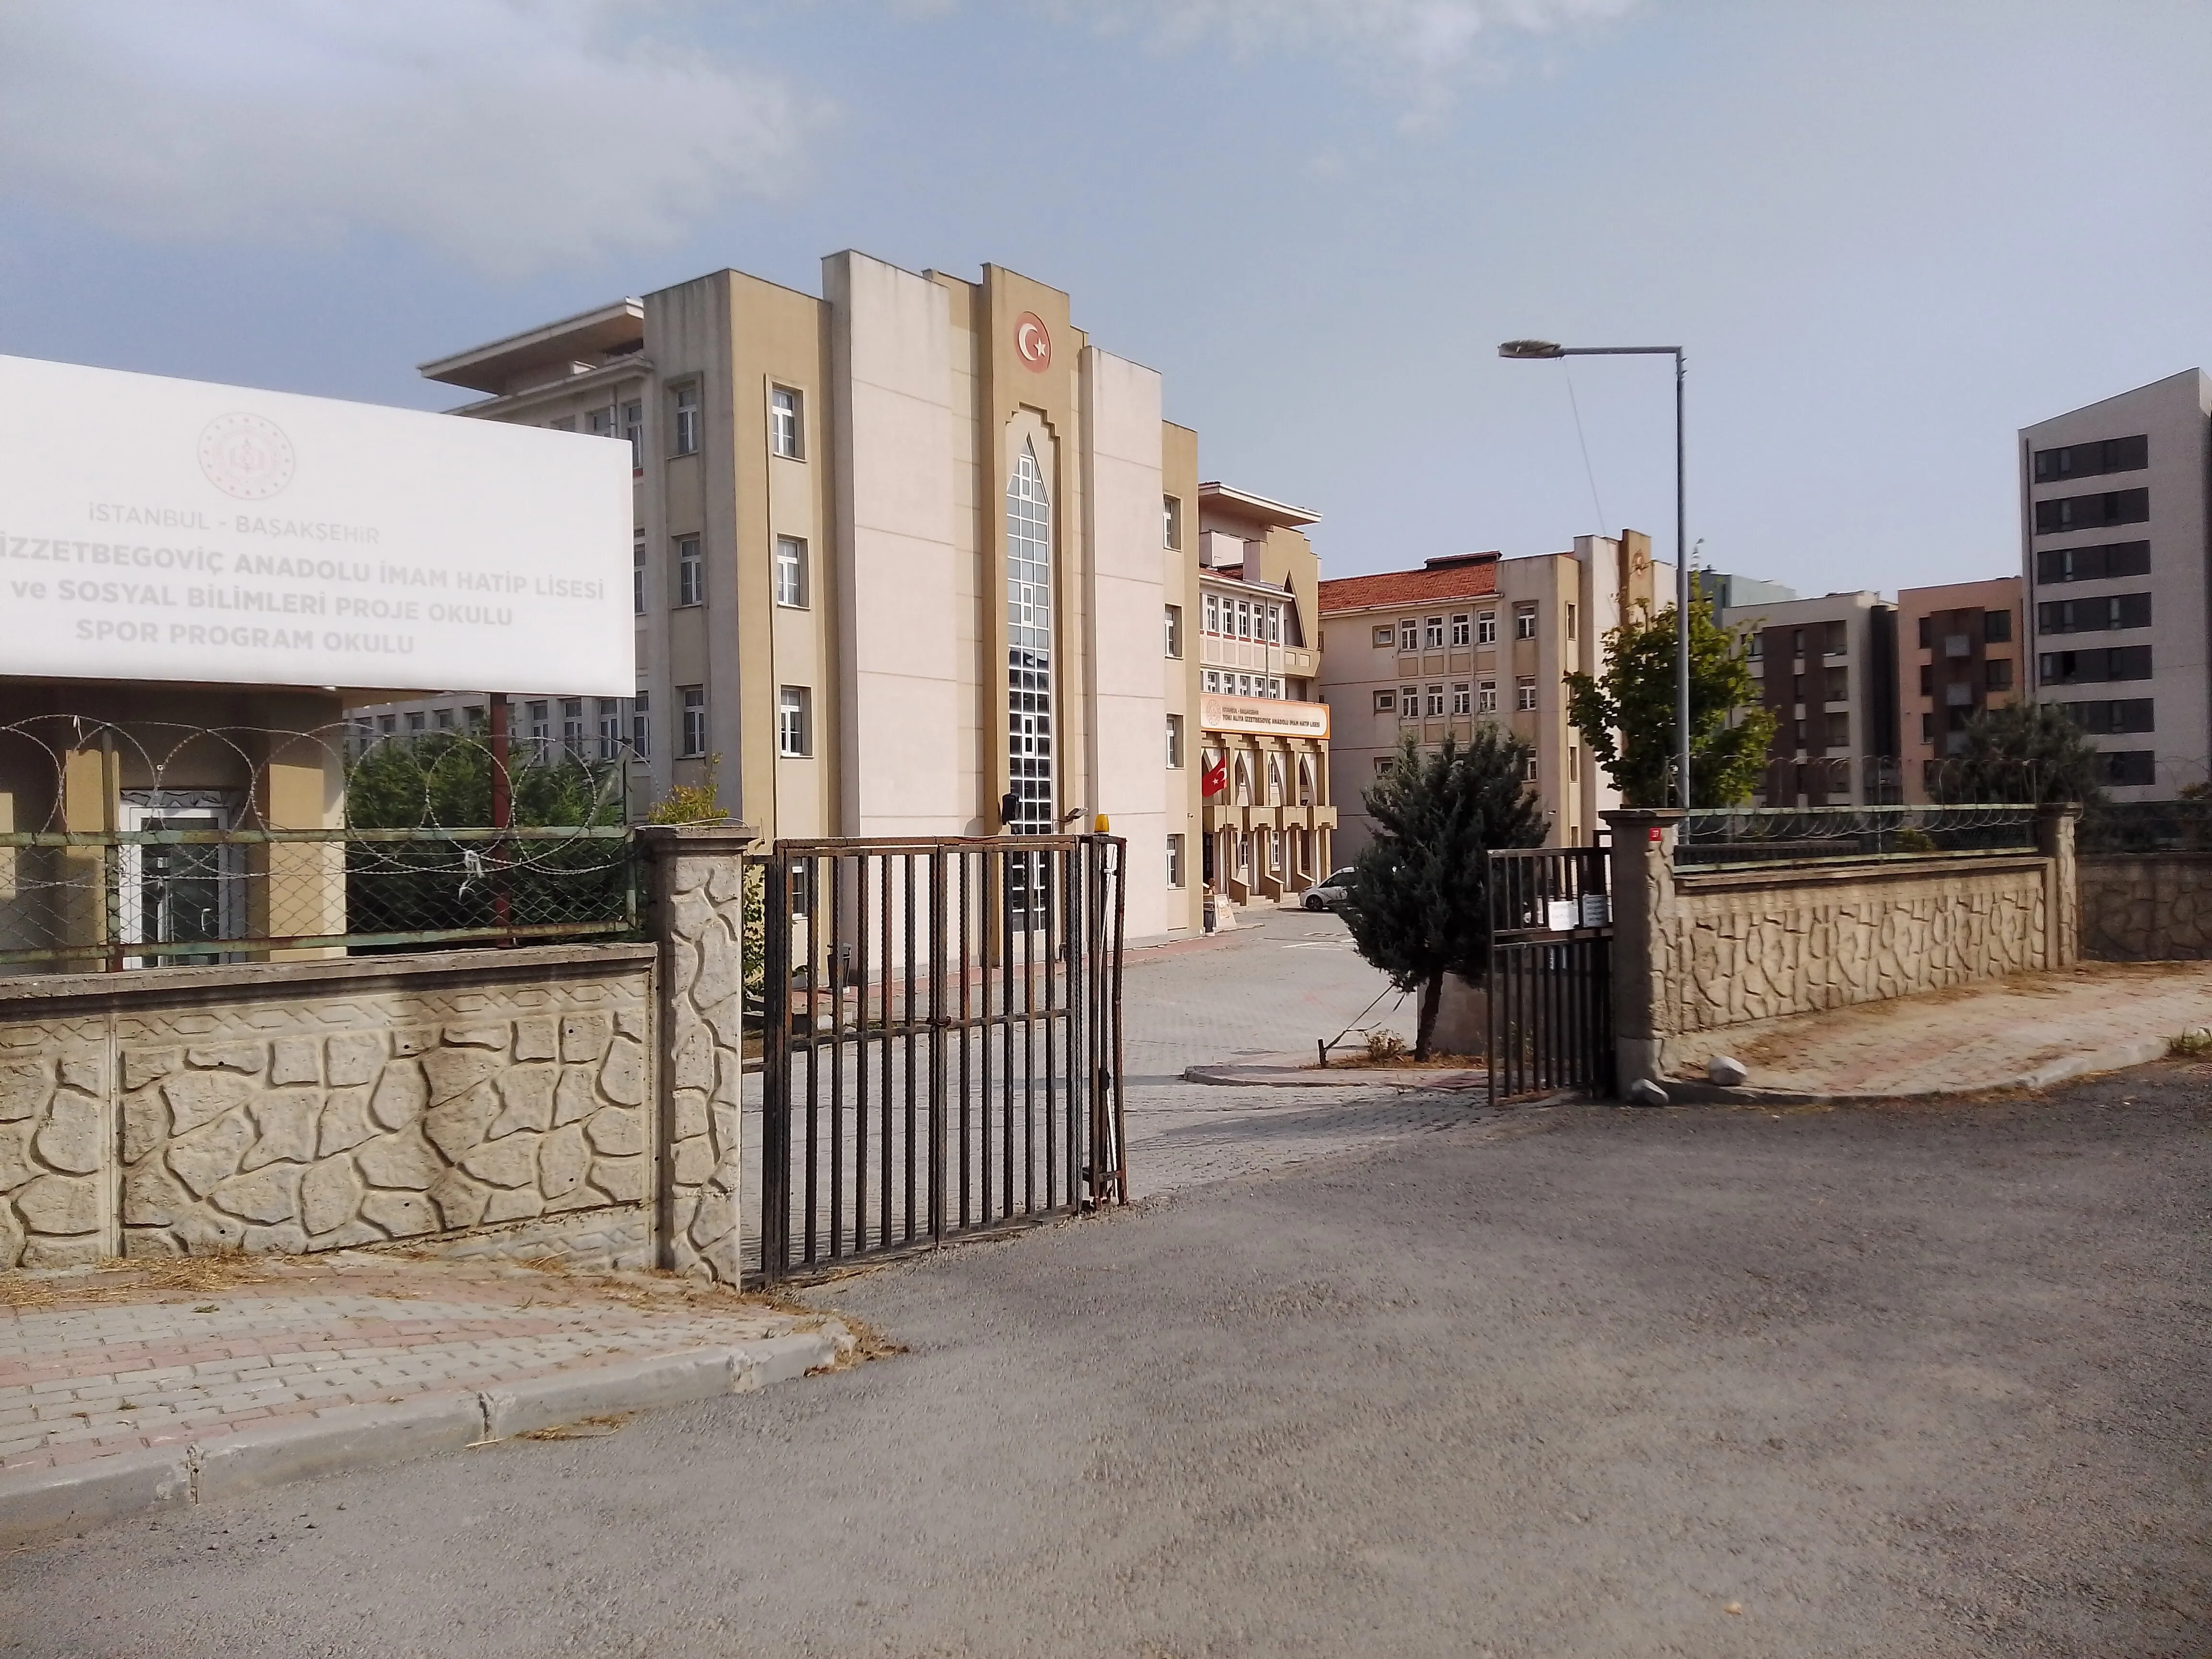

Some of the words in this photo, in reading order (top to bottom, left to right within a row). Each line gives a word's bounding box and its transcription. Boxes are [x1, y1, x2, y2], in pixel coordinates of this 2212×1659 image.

[89, 502, 210, 529] İSTANBUL
[236, 515, 379, 544] BAŞAKŞEHİR
[0, 530, 224, 576] İZZETBEGOVİÇ
[234, 553, 370, 582] ANADOLU
[380, 561, 447, 588] İMAM
[457, 570, 527, 594] HATİP
[535, 574, 604, 600] LİSESİ
[11, 580, 47, 600] ve
[58, 579, 178, 606] SOSYAL
[187, 583, 326, 615] BİLİMLERİ
[336, 597, 419, 620] PROJE
[428, 603, 513, 626] OKULU
[76, 618, 158, 642] SPOR
[169, 623, 313, 650] PROGRAM
[323, 631, 413, 654] OKULU
